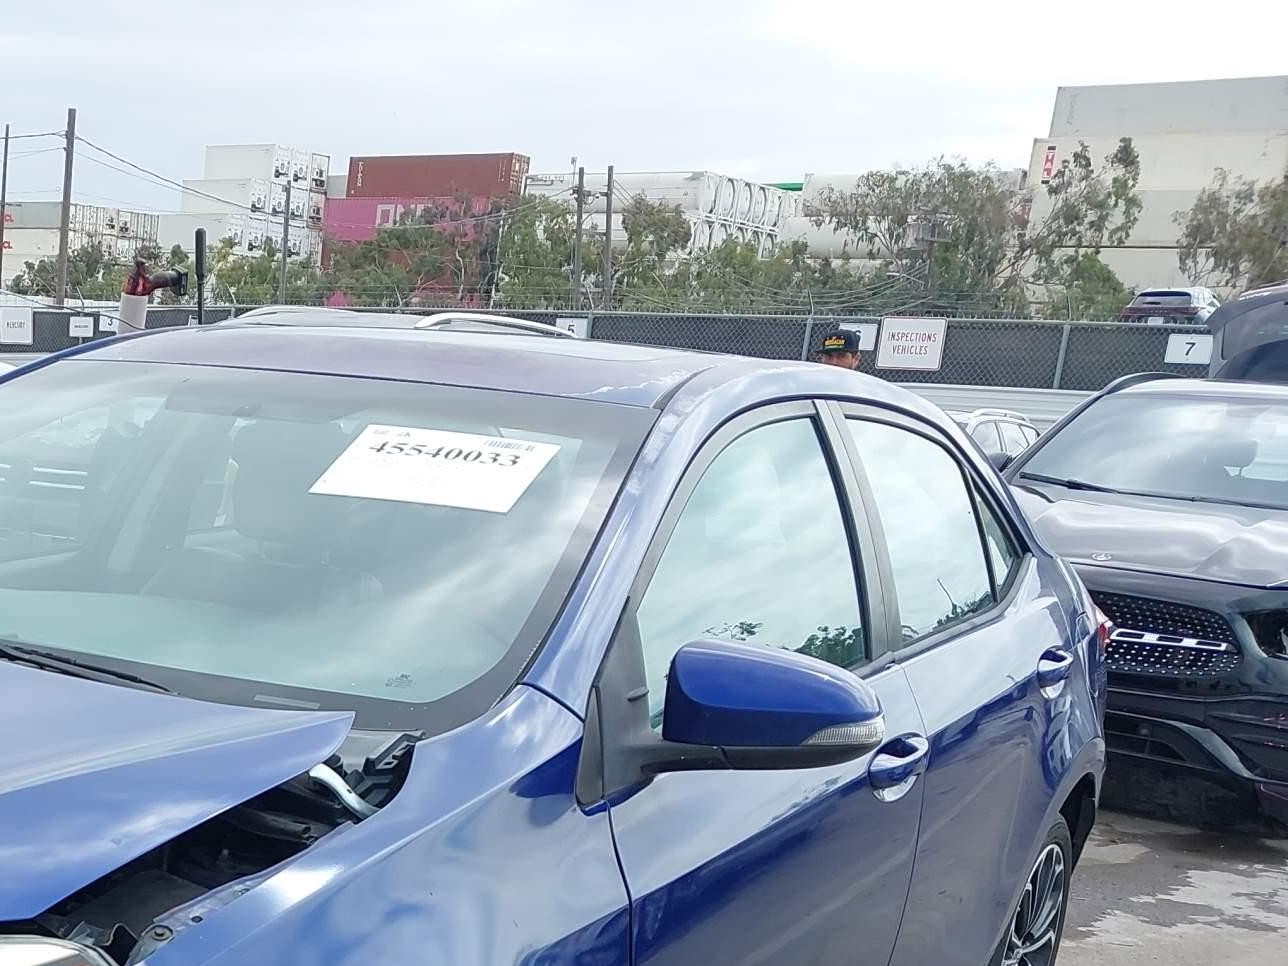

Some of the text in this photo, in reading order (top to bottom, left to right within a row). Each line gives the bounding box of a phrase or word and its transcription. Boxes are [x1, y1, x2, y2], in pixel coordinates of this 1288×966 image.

[1043, 153, 1055, 178] TAL
[887, 331, 938, 343] INSPECTIONS
[891, 345, 929, 356] VEHICLES
[1184, 341, 1197, 357] 7
[369, 440, 521, 467] 45540033
